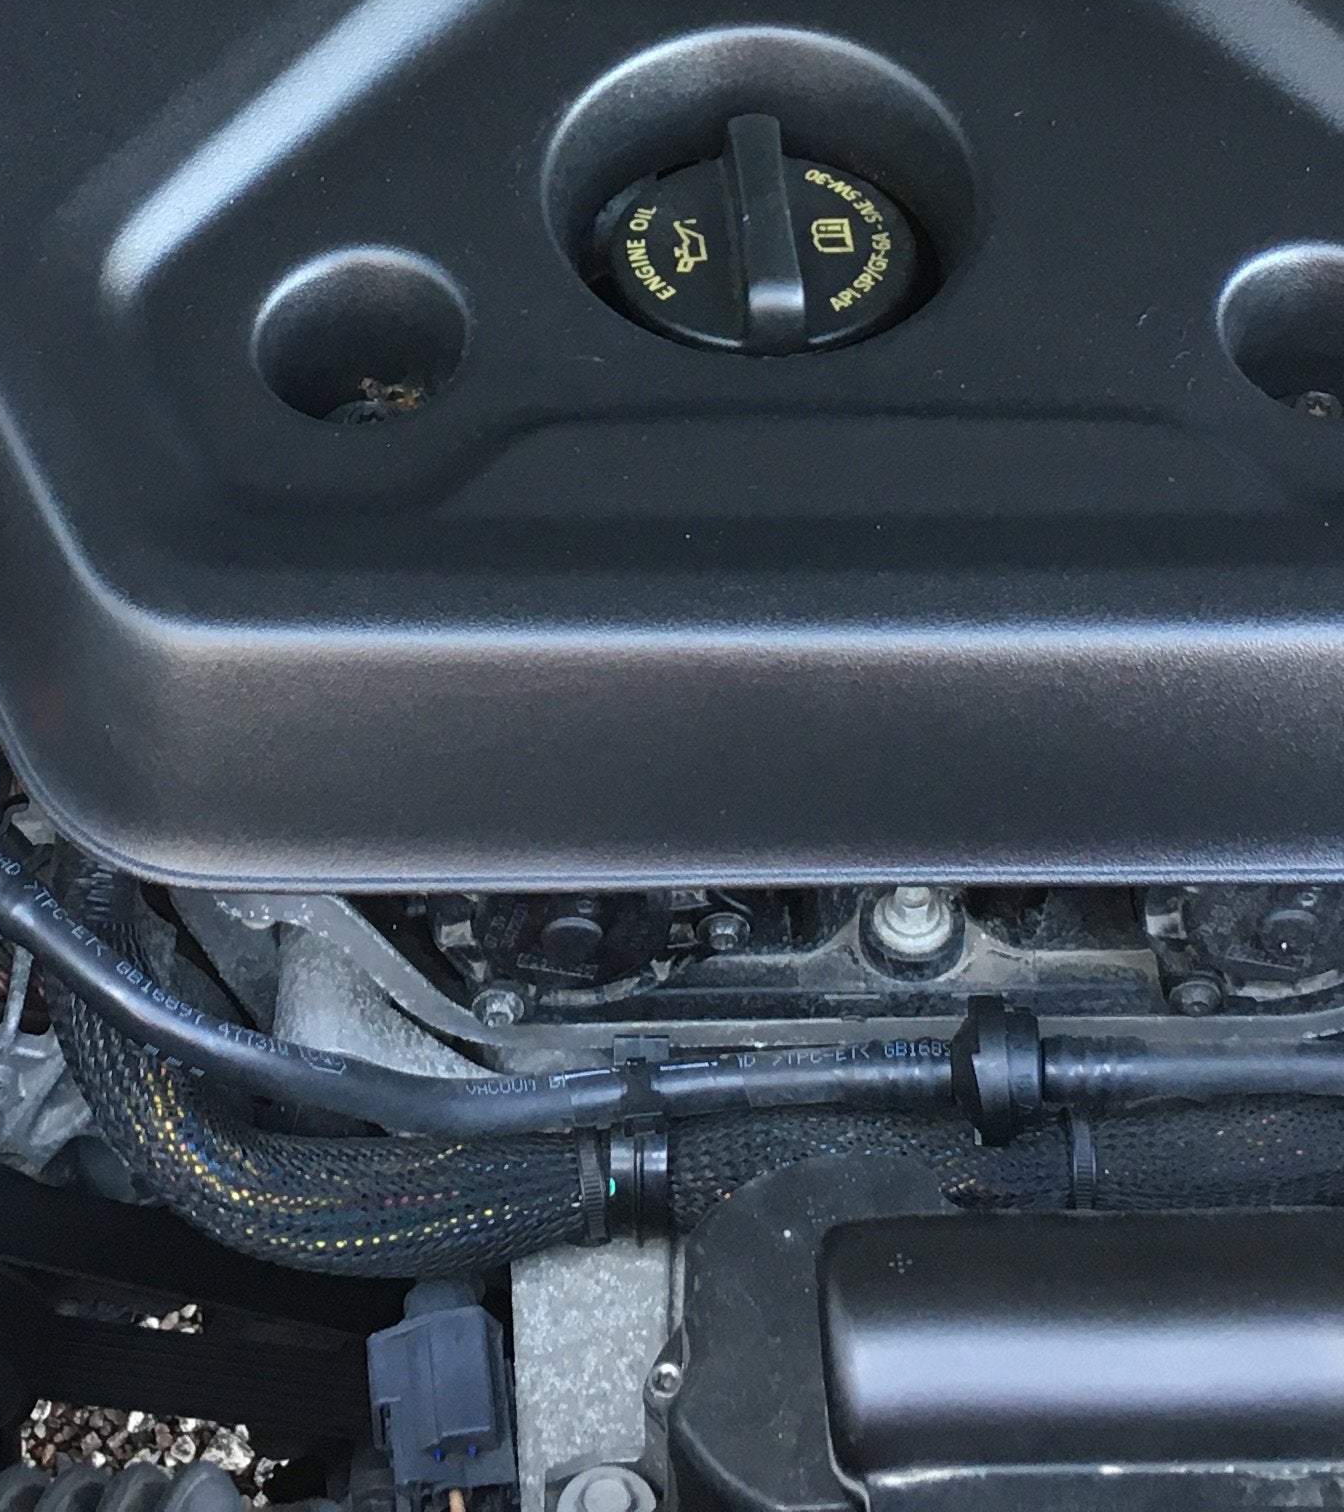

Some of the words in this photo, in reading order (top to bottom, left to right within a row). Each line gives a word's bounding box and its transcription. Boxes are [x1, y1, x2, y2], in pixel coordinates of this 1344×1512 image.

[804, 168, 862, 203] 5W-30
[628, 205, 658, 232] OIL
[853, 197, 883, 224] SAE
[626, 239, 677, 302] ENGINE
[829, 287, 862, 312] API
